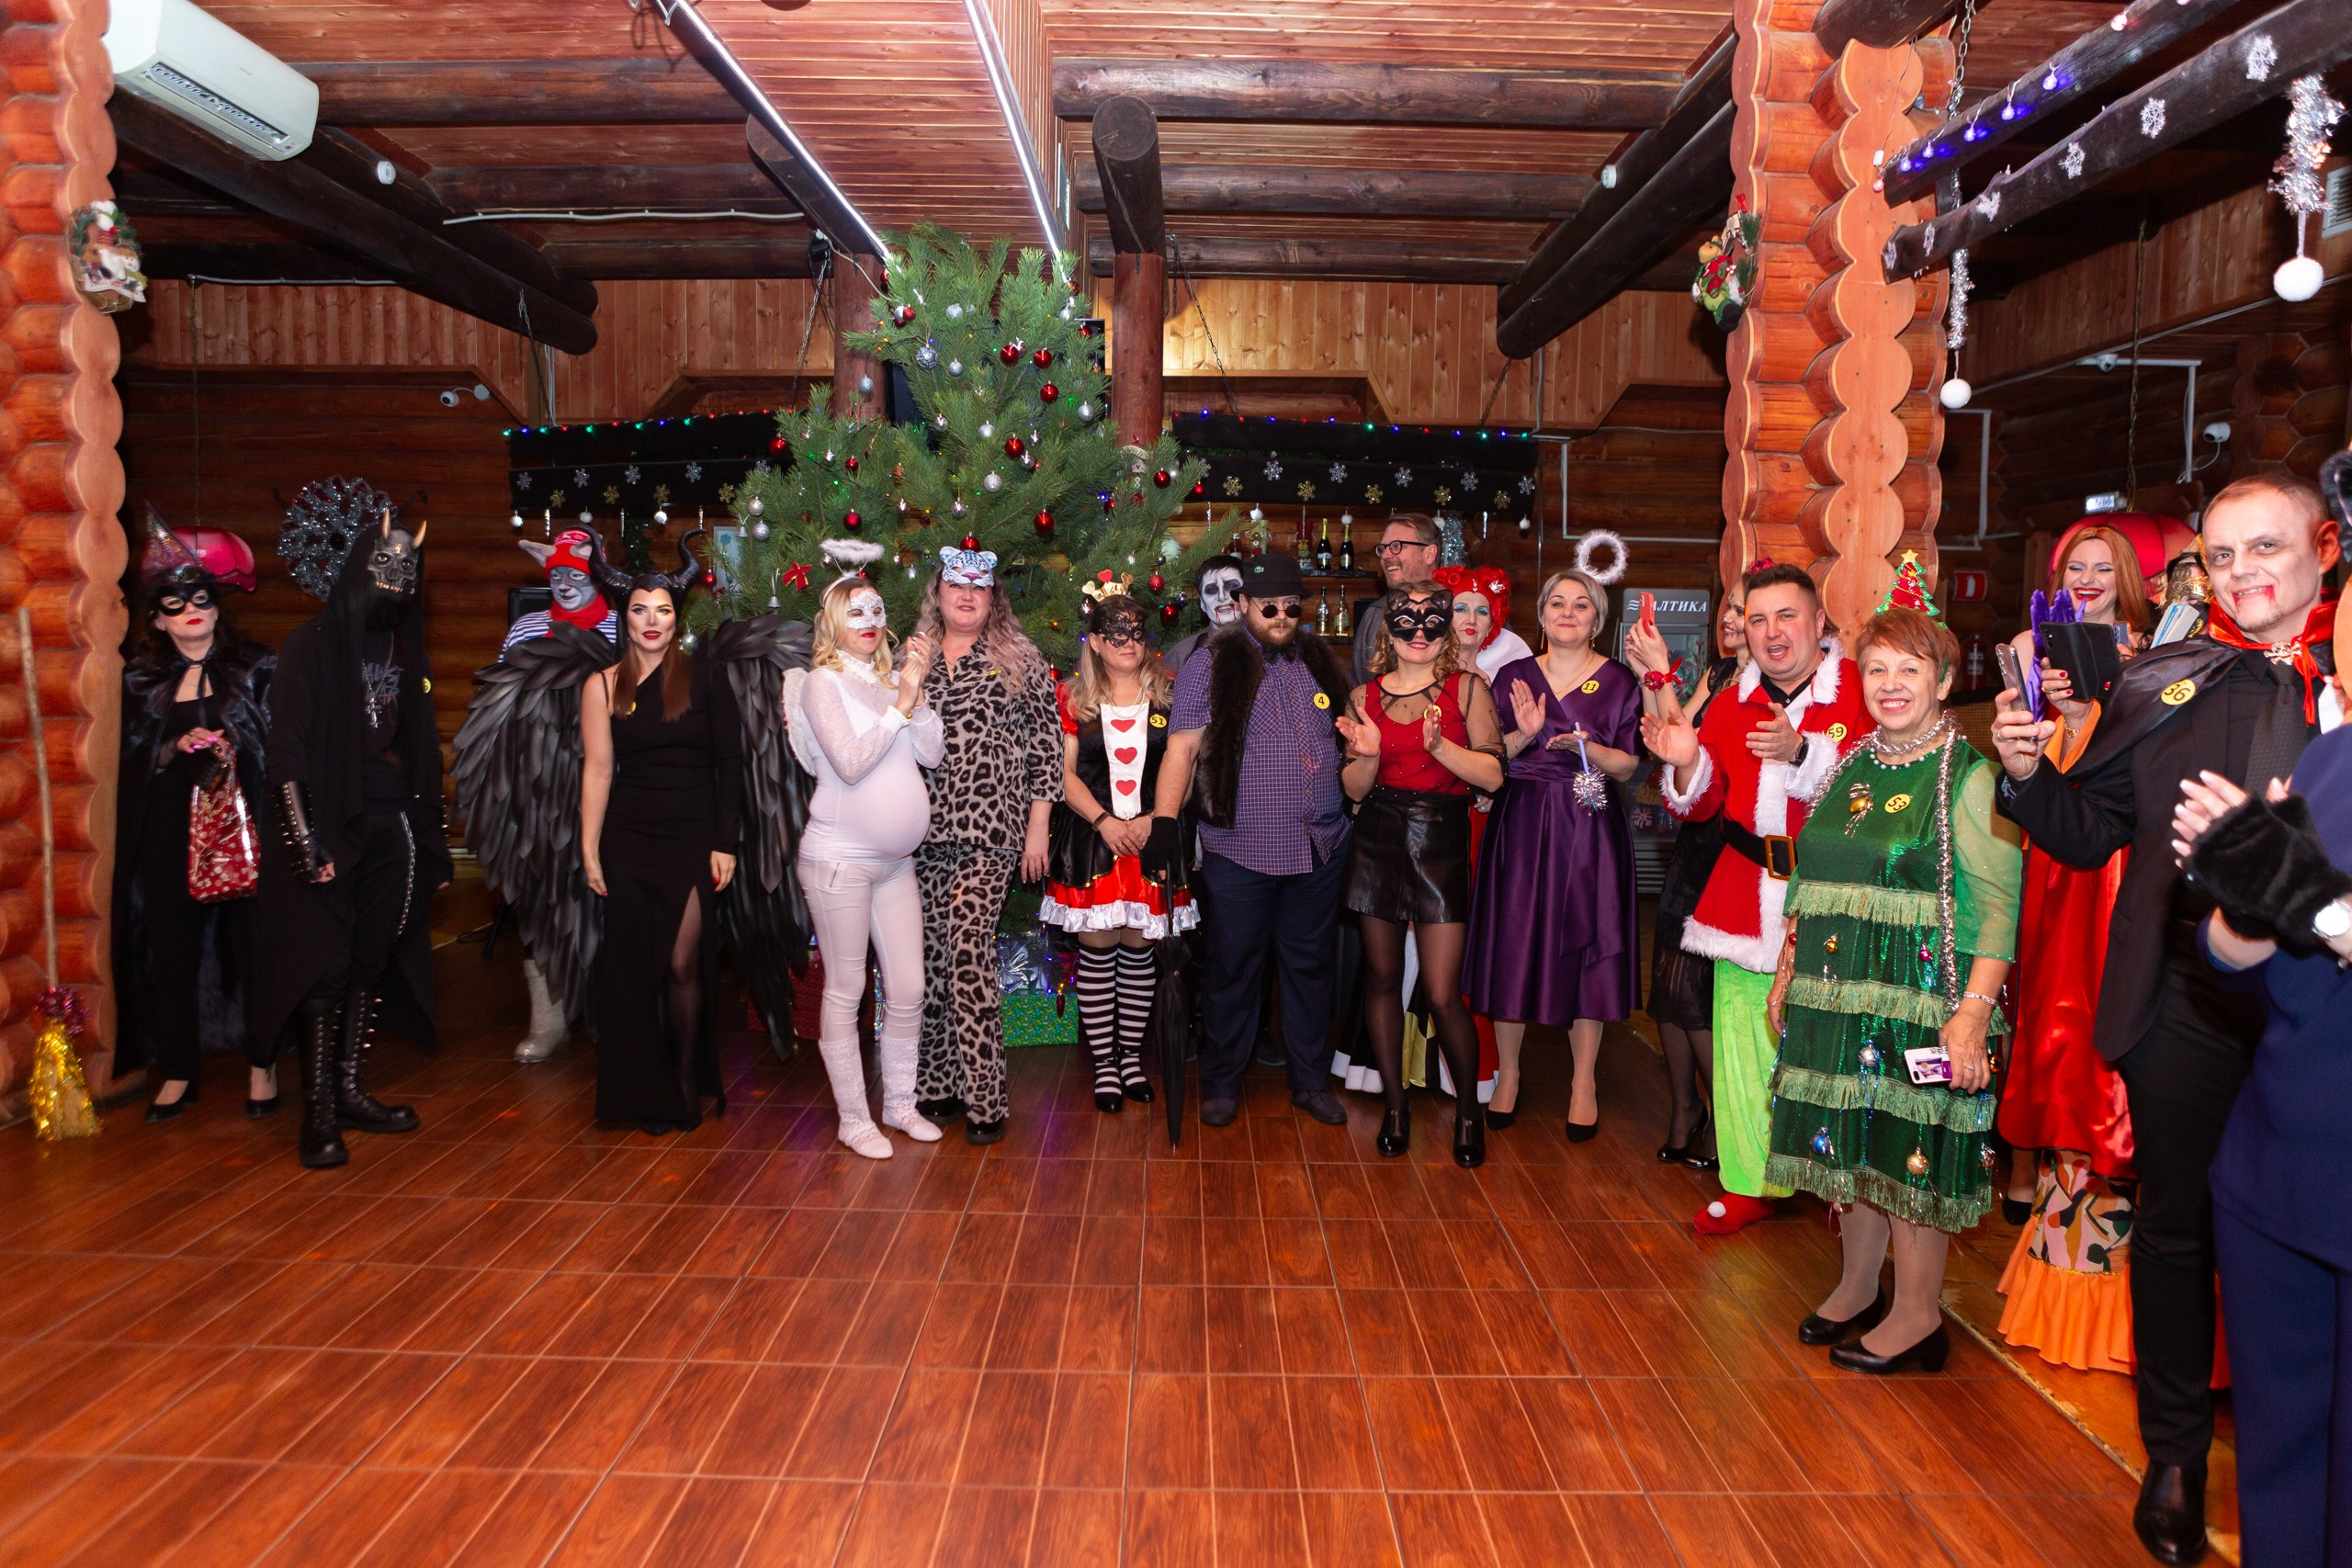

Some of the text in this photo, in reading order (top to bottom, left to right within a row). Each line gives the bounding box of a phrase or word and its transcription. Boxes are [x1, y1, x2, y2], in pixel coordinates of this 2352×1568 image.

[1651, 600, 1707, 613] АЛТИКА
[1582, 682, 1597, 692] 11
[2164, 683, 2191, 702] 36
[1317, 695, 1326, 705] 4
[1151, 716, 1165, 726] 51
[1828, 726, 1844, 739] 59
[1887, 795, 1907, 811] 53
